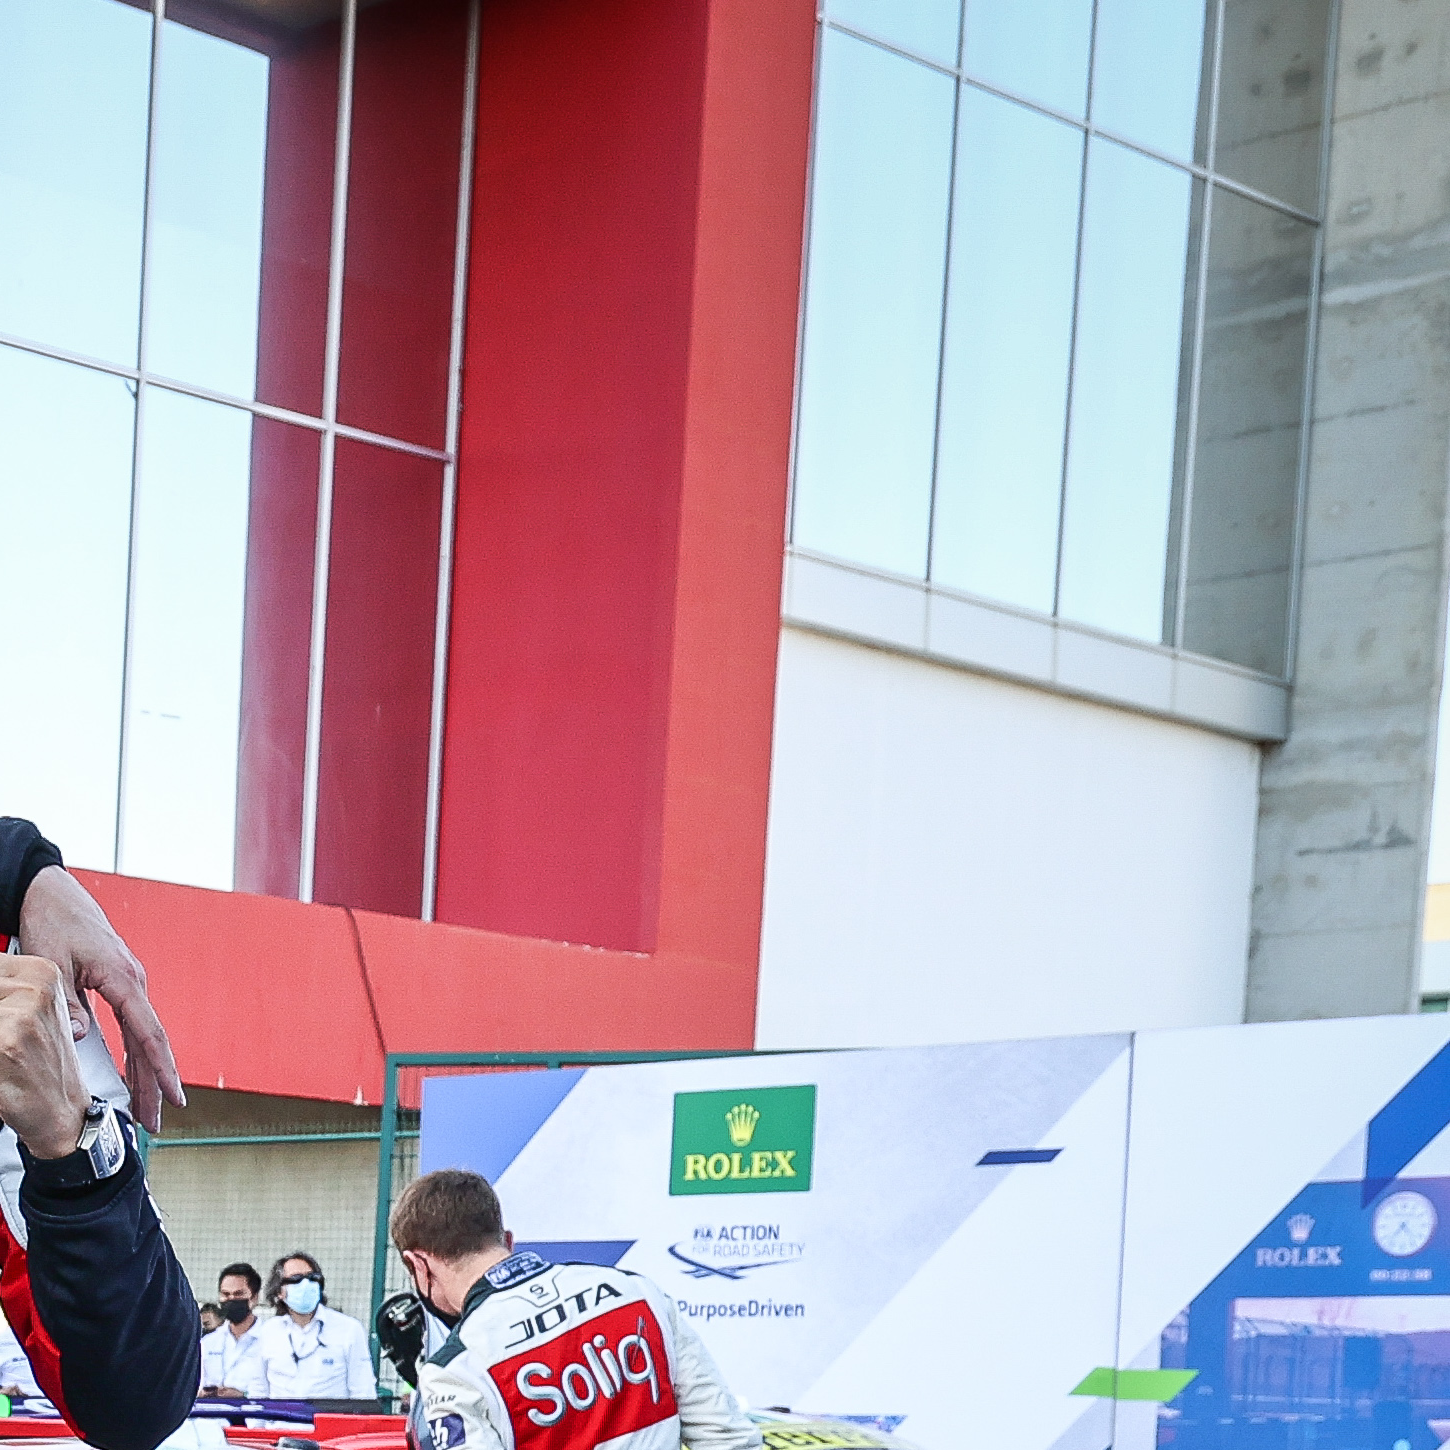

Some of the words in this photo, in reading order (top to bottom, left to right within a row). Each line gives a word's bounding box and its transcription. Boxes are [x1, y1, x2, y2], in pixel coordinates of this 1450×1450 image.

[683, 1150, 798, 1181] ROLEX
[717, 1224, 781, 1241] ACTION
[713, 1243, 750, 1258] ROAD
[753, 1242, 806, 1258] SAFETY
[1255, 1246, 1344, 1268] ROLEX
[505, 1282, 623, 1350] JOTA
